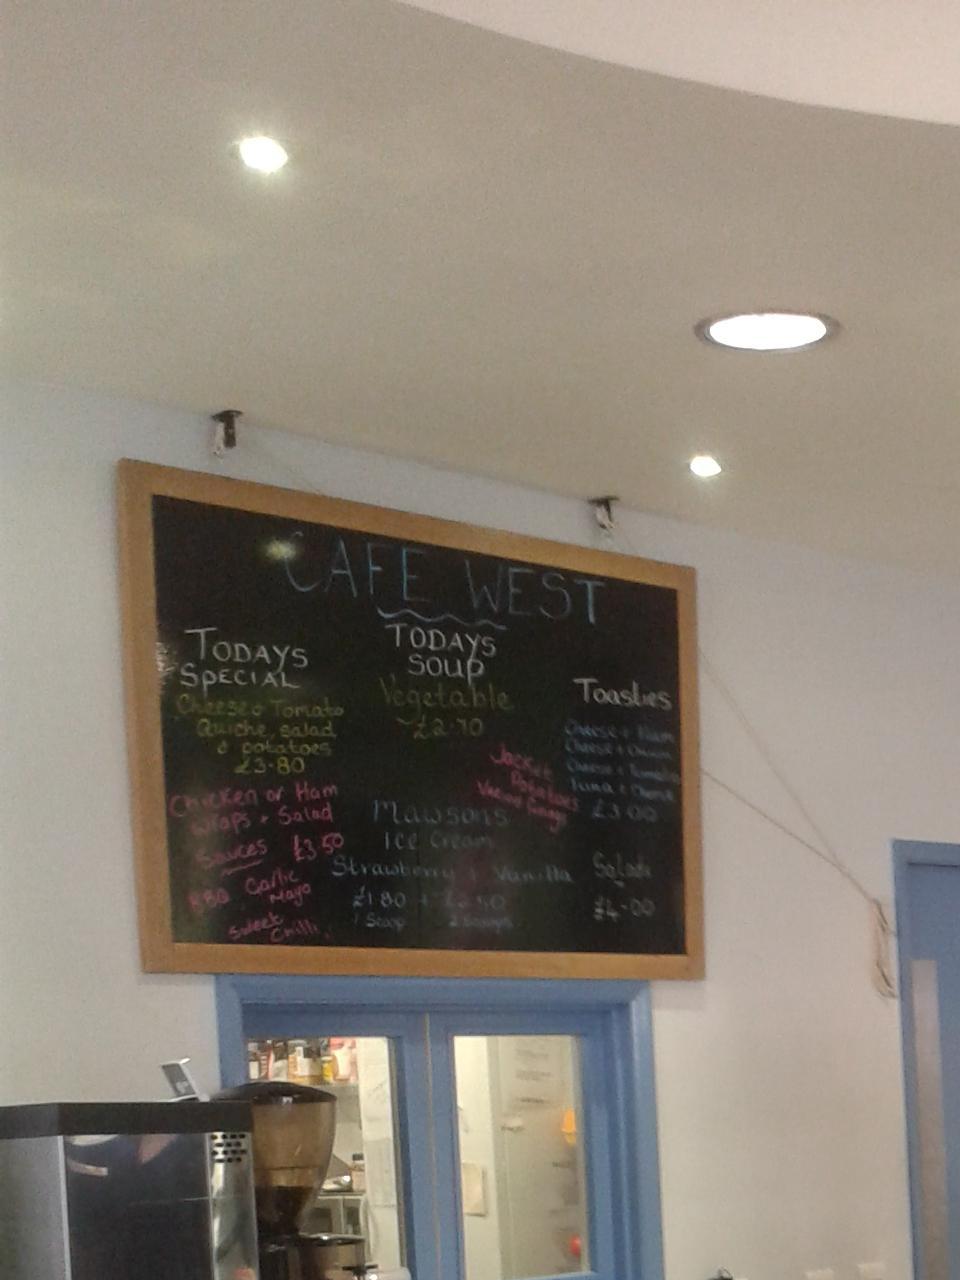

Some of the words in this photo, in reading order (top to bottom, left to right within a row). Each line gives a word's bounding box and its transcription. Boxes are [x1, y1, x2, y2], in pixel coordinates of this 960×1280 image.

[463, 557, 605, 625] WEST
[184, 627, 309, 676] TODAYS
[384, 622, 498, 660] TODAYS
[180, 663, 300, 698] SPECIAL
[379, 674, 515, 722] Vegetable
[573, 677, 673, 711] Toasties
[269, 698, 345, 718] Tomato
[294, 780, 339, 801] Ham
[277, 801, 335, 827] Salad
